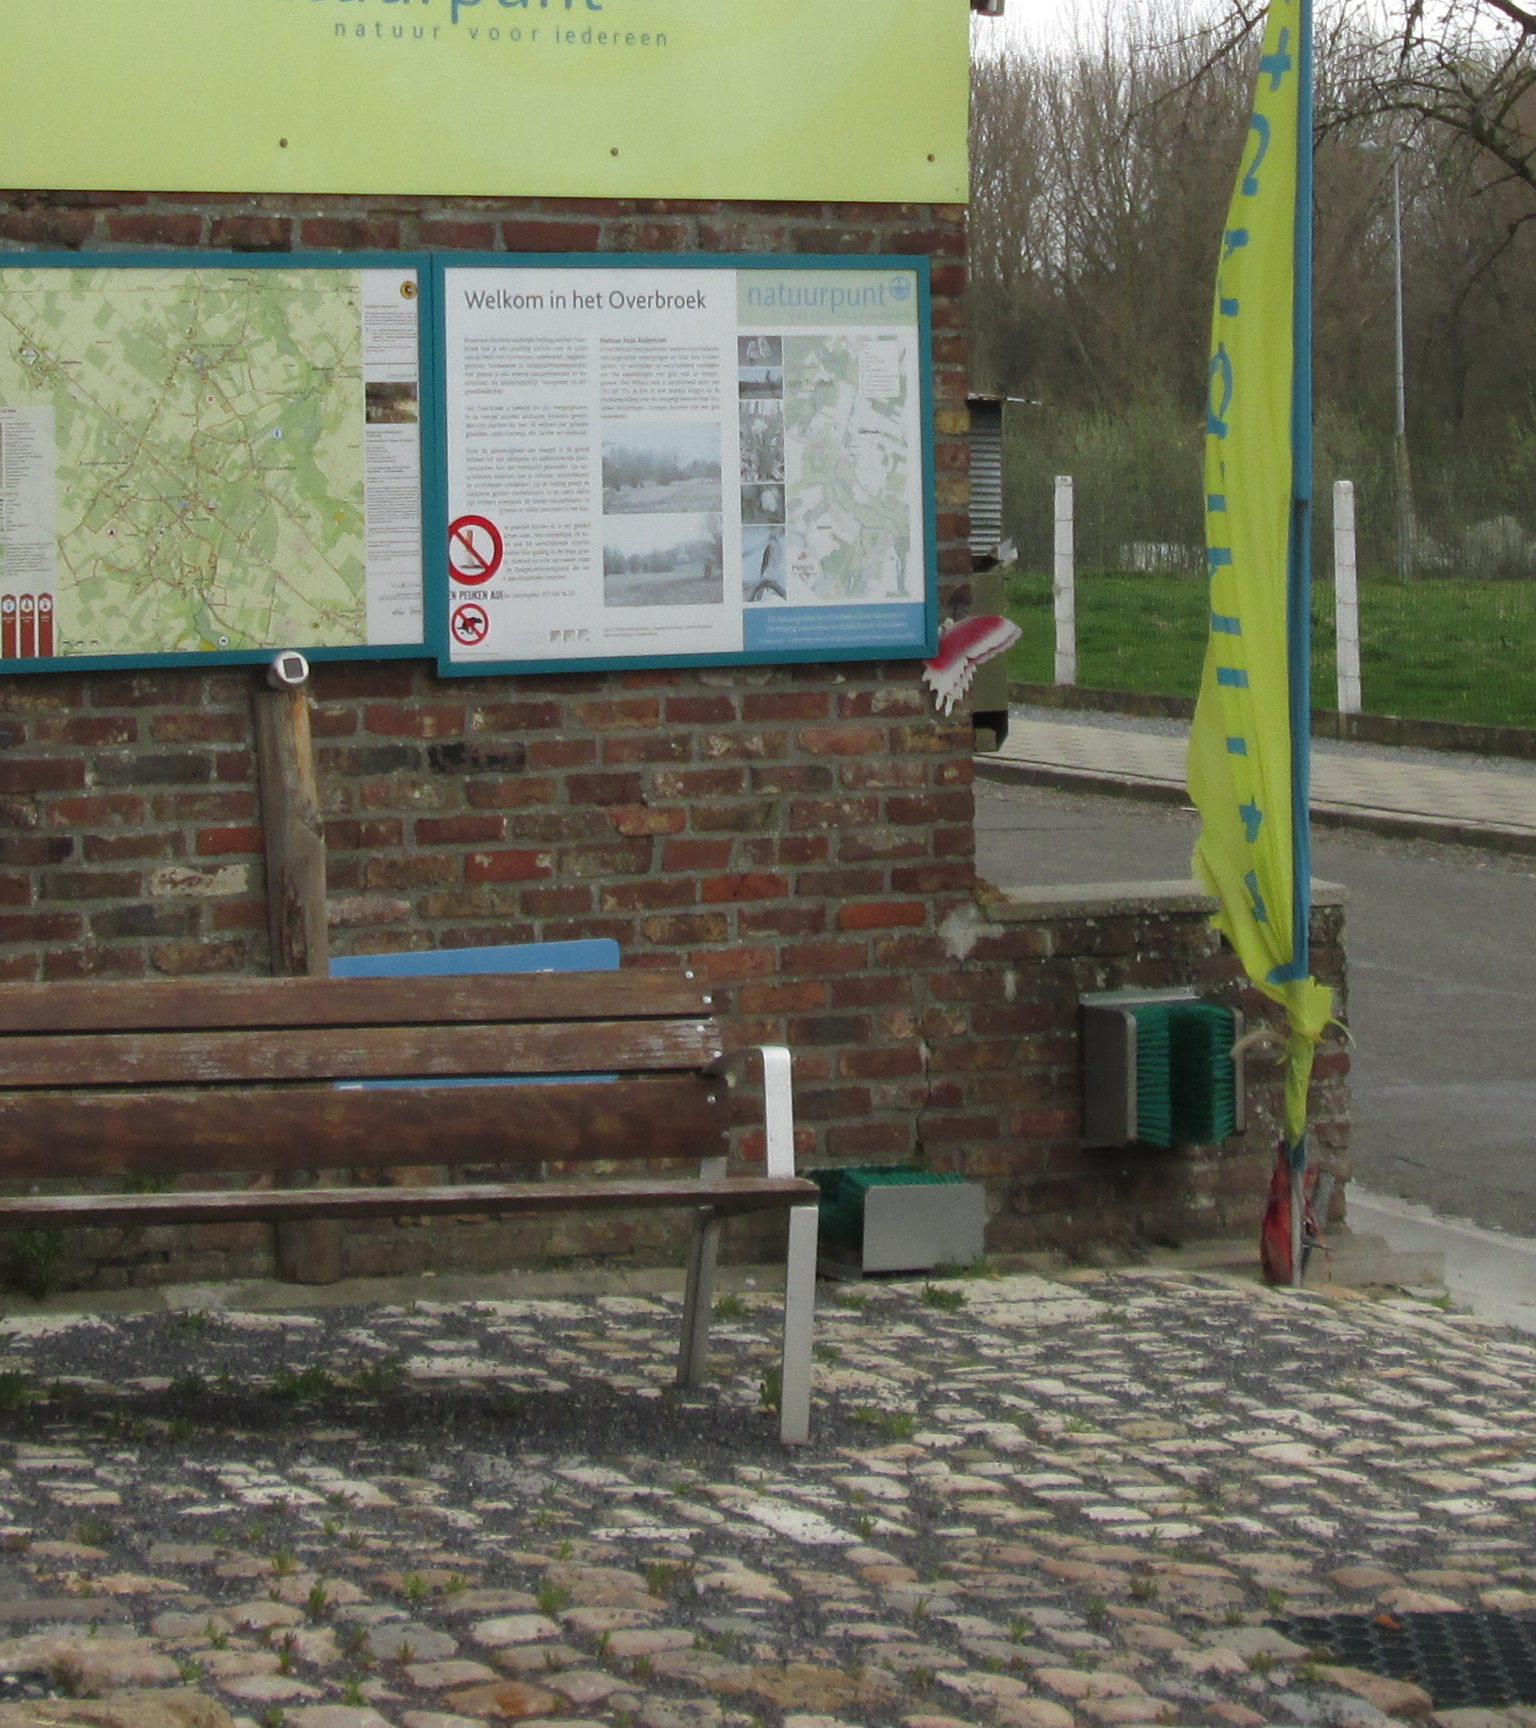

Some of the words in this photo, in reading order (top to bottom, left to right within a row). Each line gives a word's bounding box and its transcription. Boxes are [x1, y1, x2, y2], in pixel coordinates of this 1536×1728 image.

[334, 19, 441, 41] natuur
[468, 24, 539, 44] voor
[554, 24, 668, 48] iedereen
[463, 289, 543, 310] Welkom
[550, 289, 566, 309] in
[572, 289, 603, 310] het
[608, 289, 707, 310] Overbroek
[747, 282, 887, 313] natuurpunt
